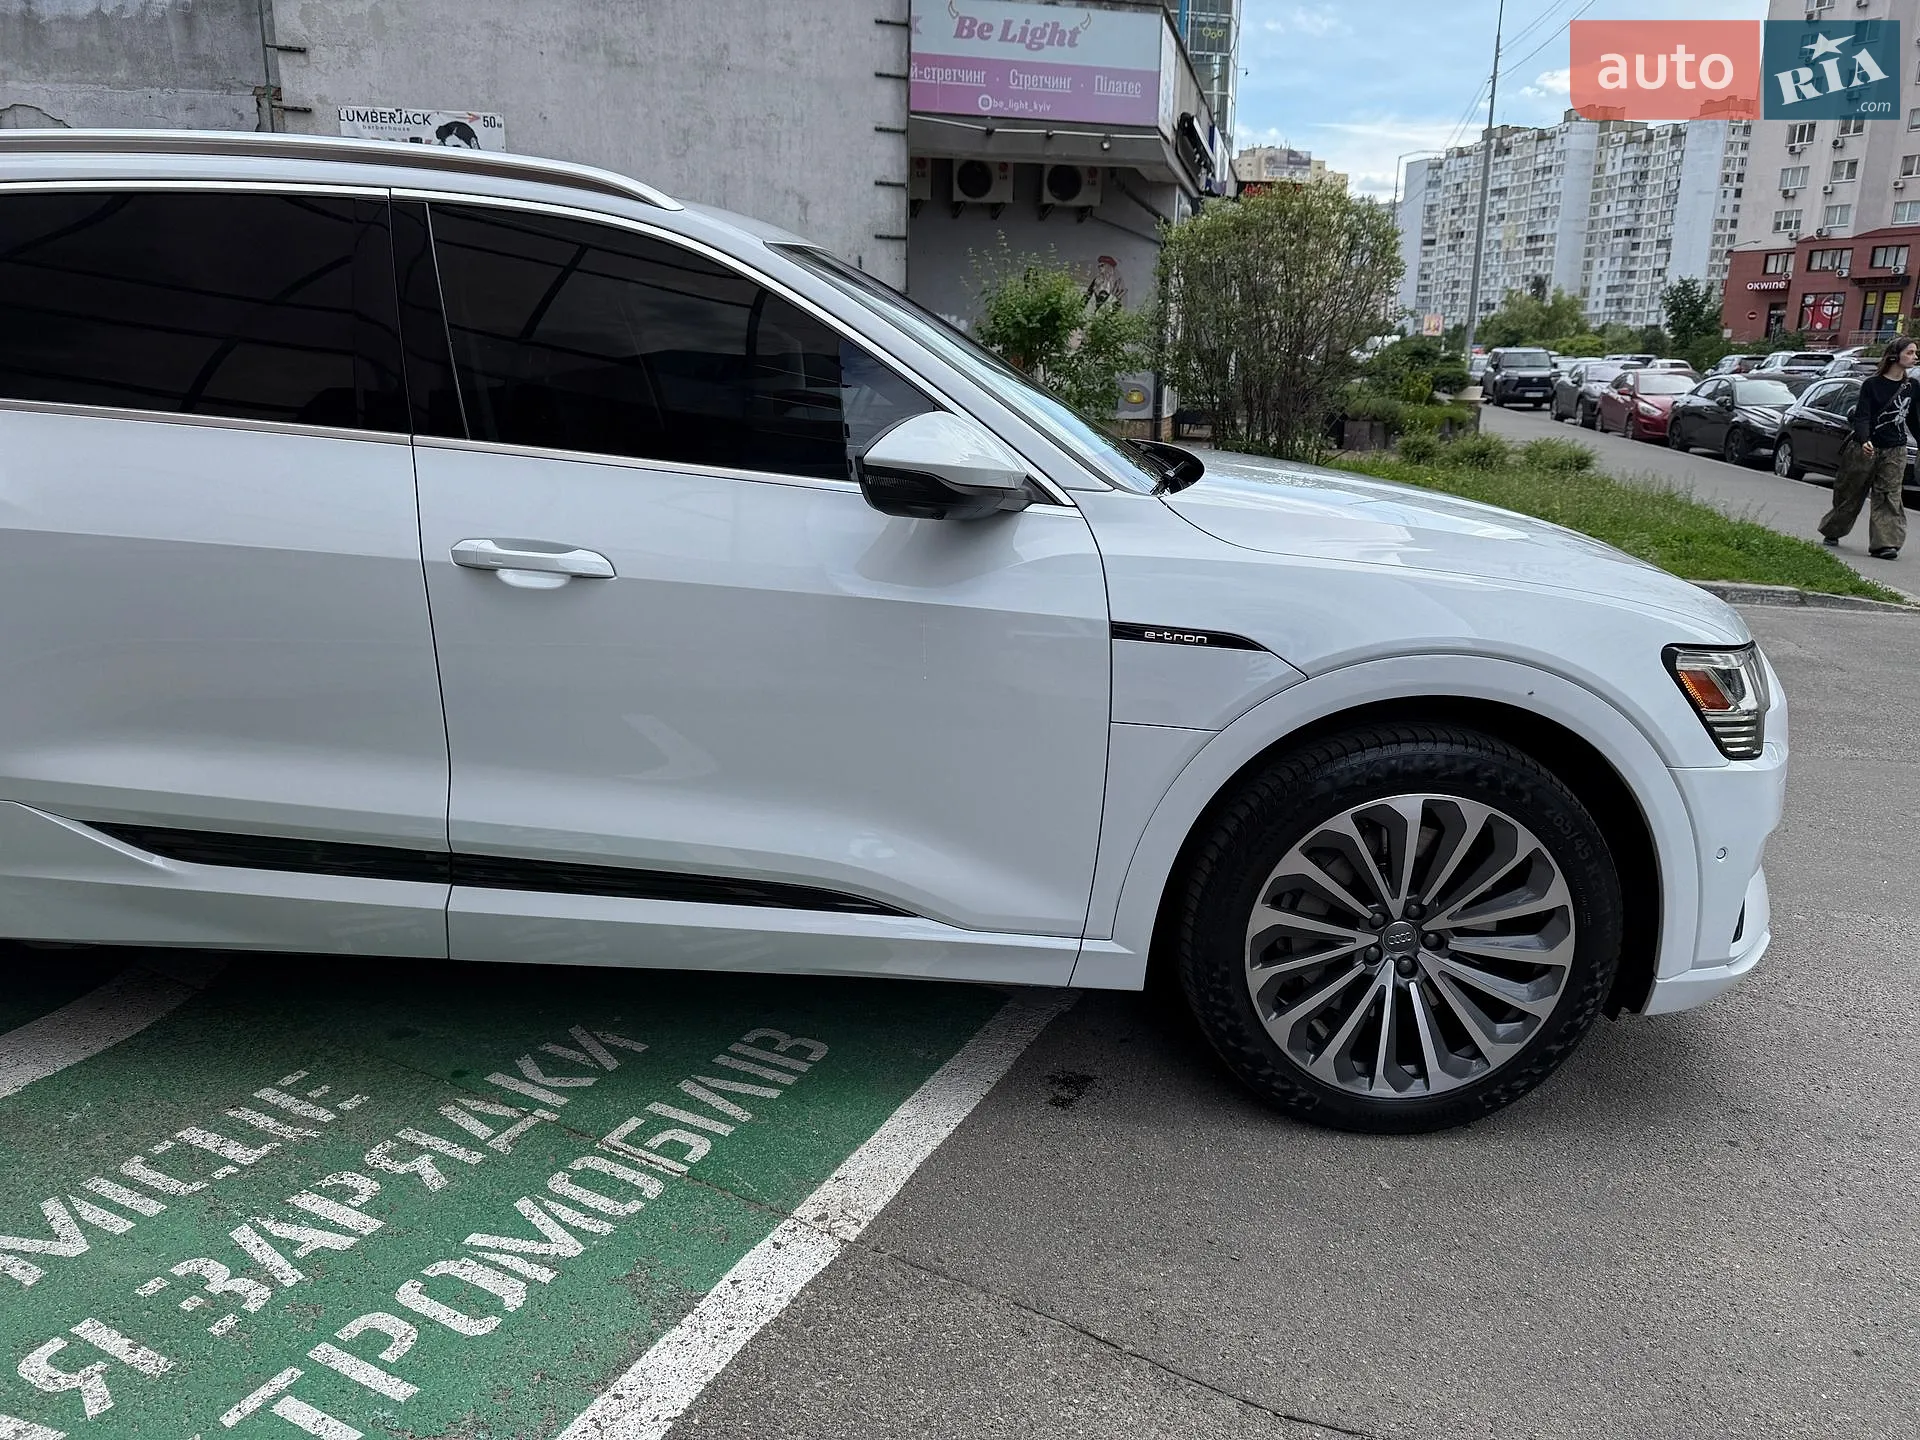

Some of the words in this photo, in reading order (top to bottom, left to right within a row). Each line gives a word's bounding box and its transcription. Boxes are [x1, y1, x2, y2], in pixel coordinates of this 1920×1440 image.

[953, 14, 994, 41] Be
[998, 18, 1082, 51] Light
[1009, 68, 1072, 91] Стретчинг
[1094, 75, 1142, 95] Пілатес
[337, 108, 432, 127] LUMBERJACK
[362, 124, 411, 133] barberhouse
[1144, 630, 1208, 644] e-tron
[134, 1024, 650, 1338] ЗАРЯДКИ
